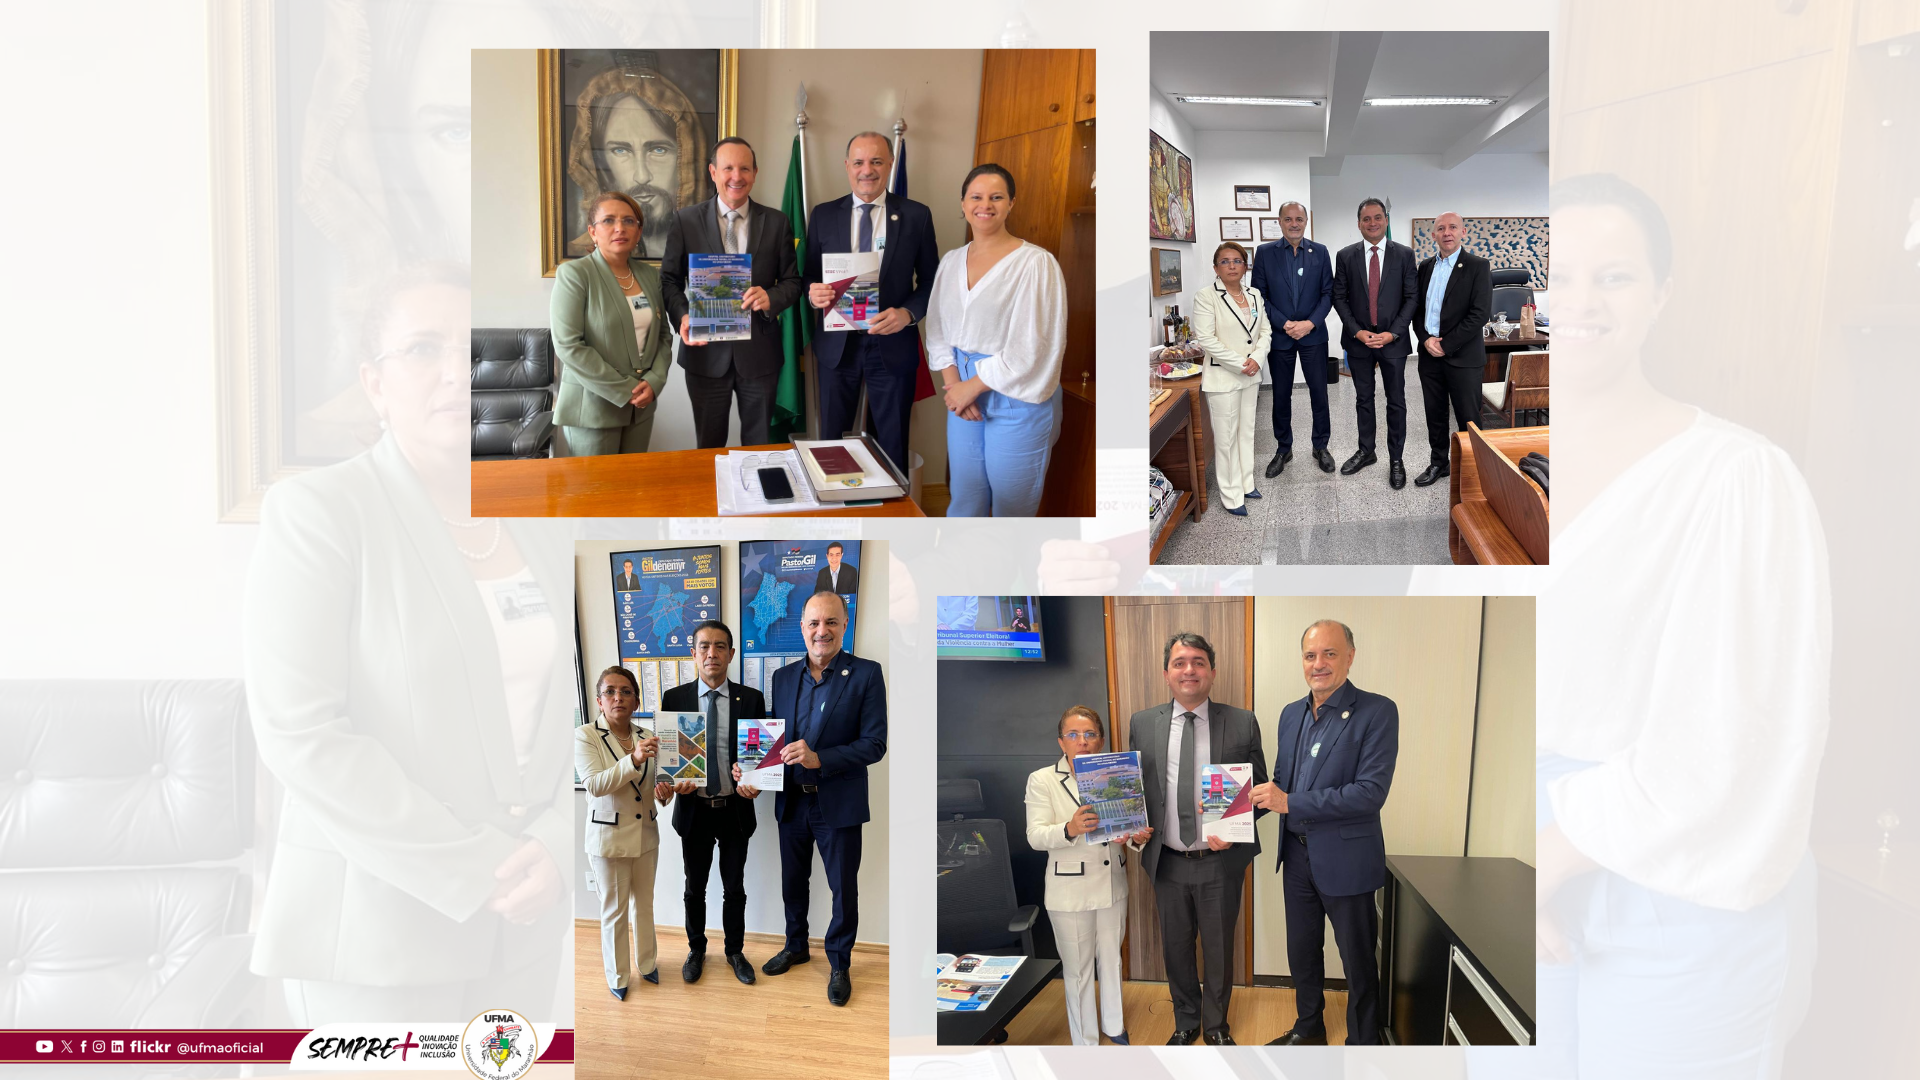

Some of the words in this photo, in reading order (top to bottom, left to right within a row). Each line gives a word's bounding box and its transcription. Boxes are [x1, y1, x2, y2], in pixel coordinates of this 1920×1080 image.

[1097, 500, 1119, 511] 202
[1121, 500, 1149, 510] FMA
[641, 559, 686, 572] Gildenemyr
[781, 554, 816, 566] PastorGil
[959, 632, 985, 640] Superior
